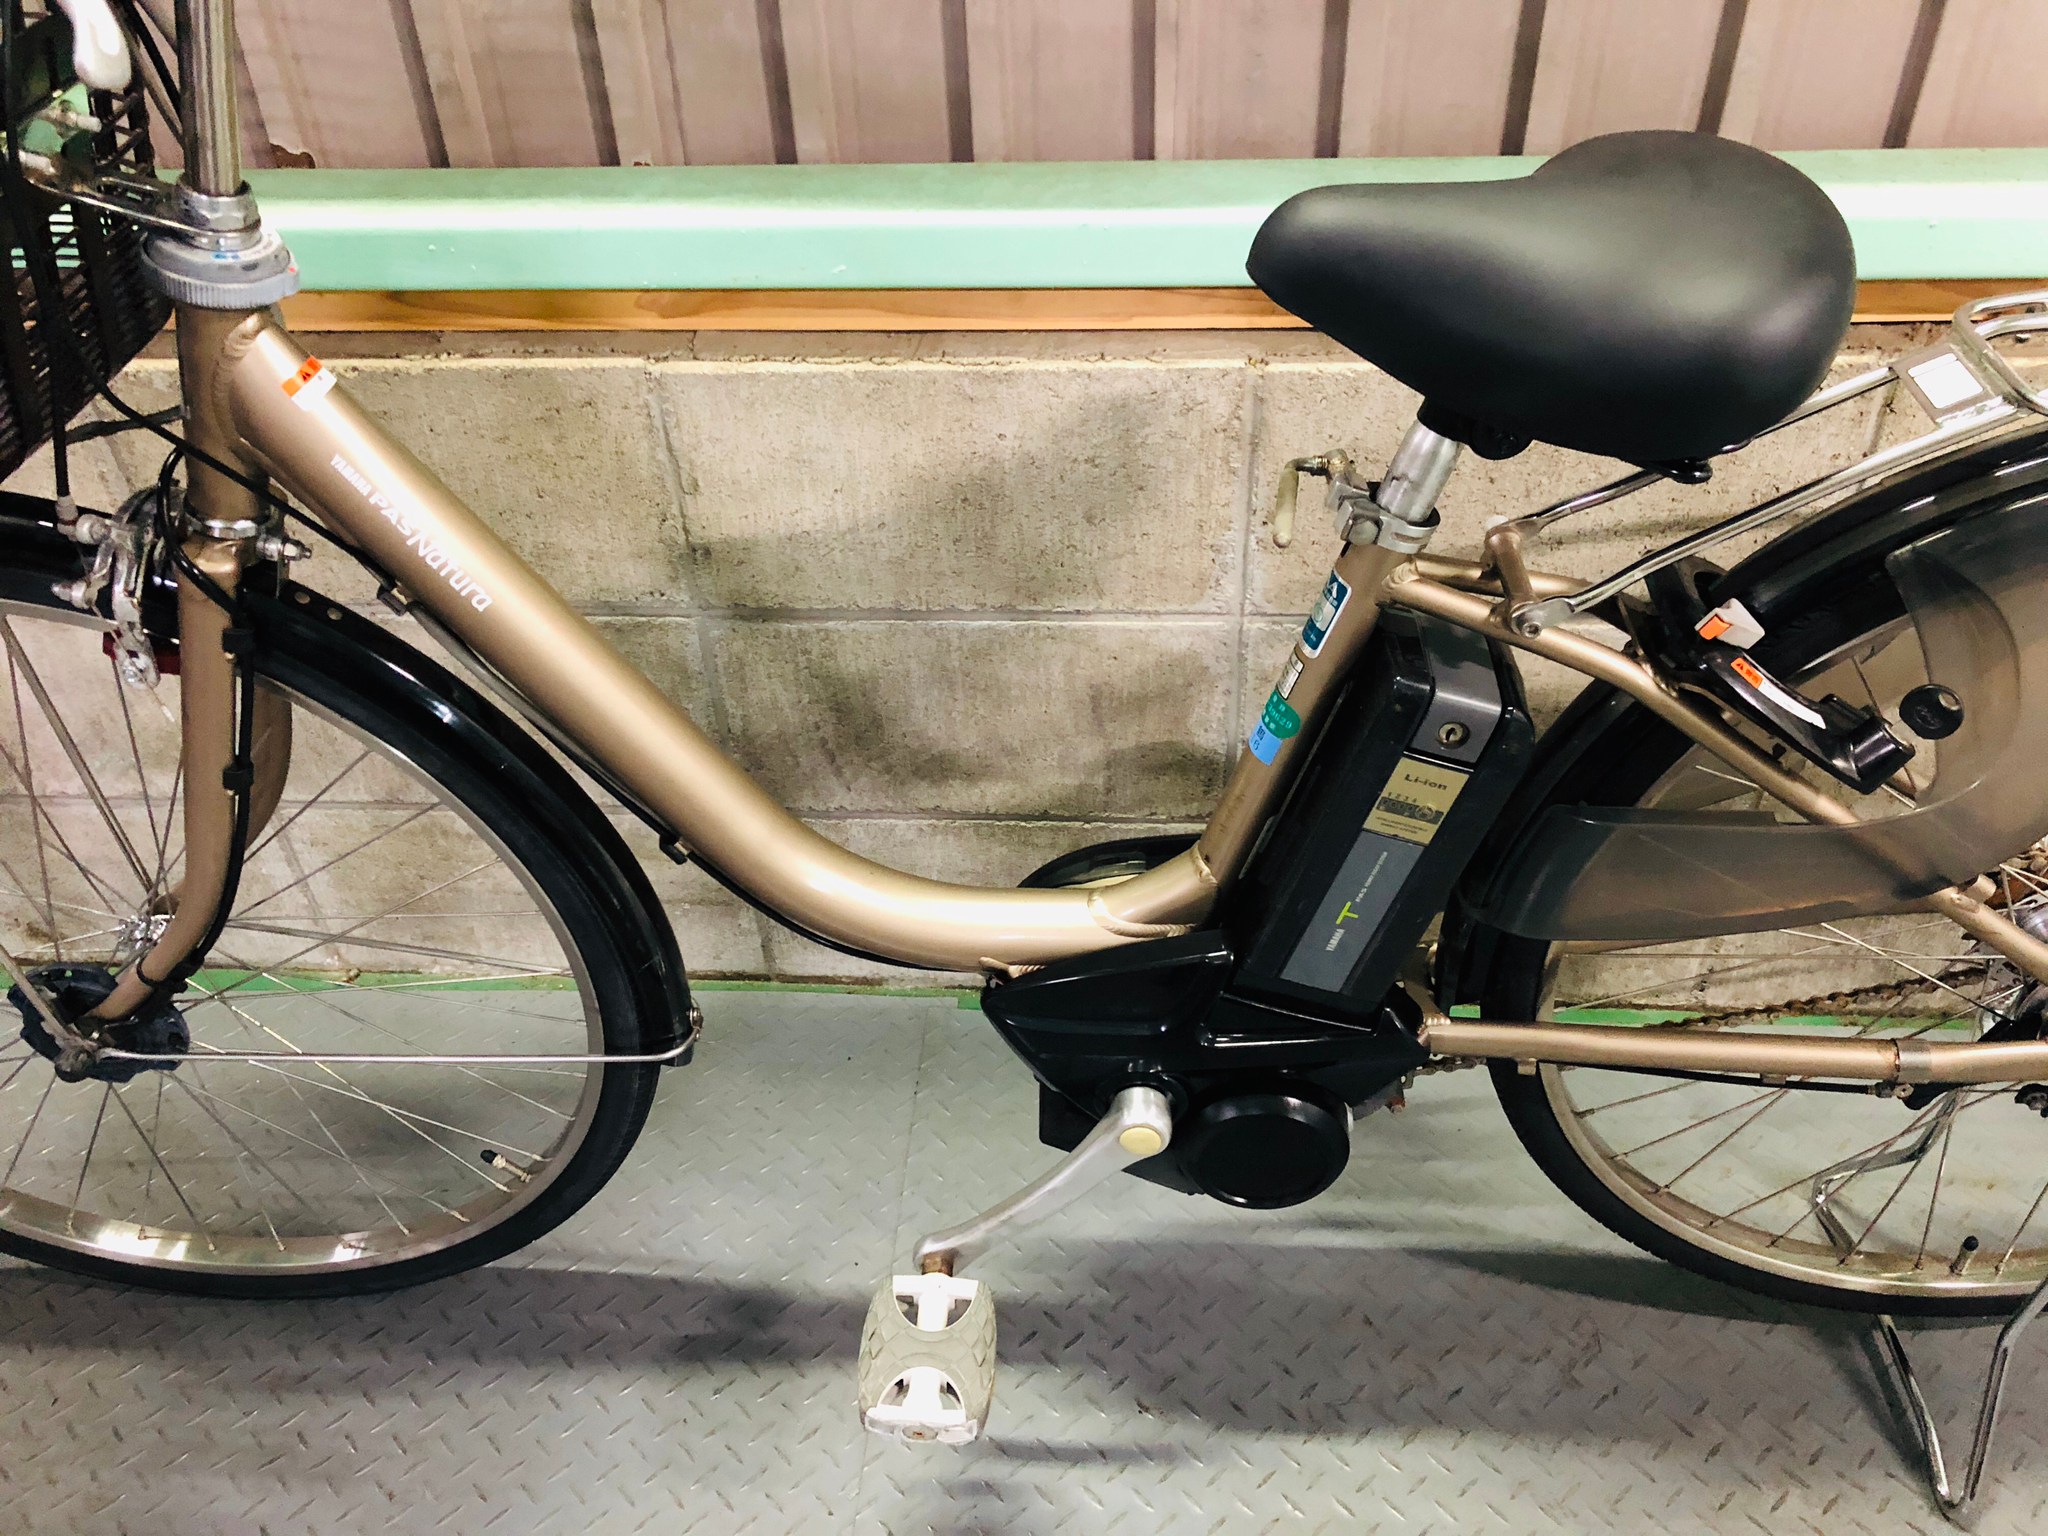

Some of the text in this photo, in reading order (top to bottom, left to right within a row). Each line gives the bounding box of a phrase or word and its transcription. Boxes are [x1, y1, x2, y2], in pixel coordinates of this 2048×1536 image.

[330, 453, 494, 612] YAMAHA PAS Natura
[1404, 773, 1448, 791] Li-ion
